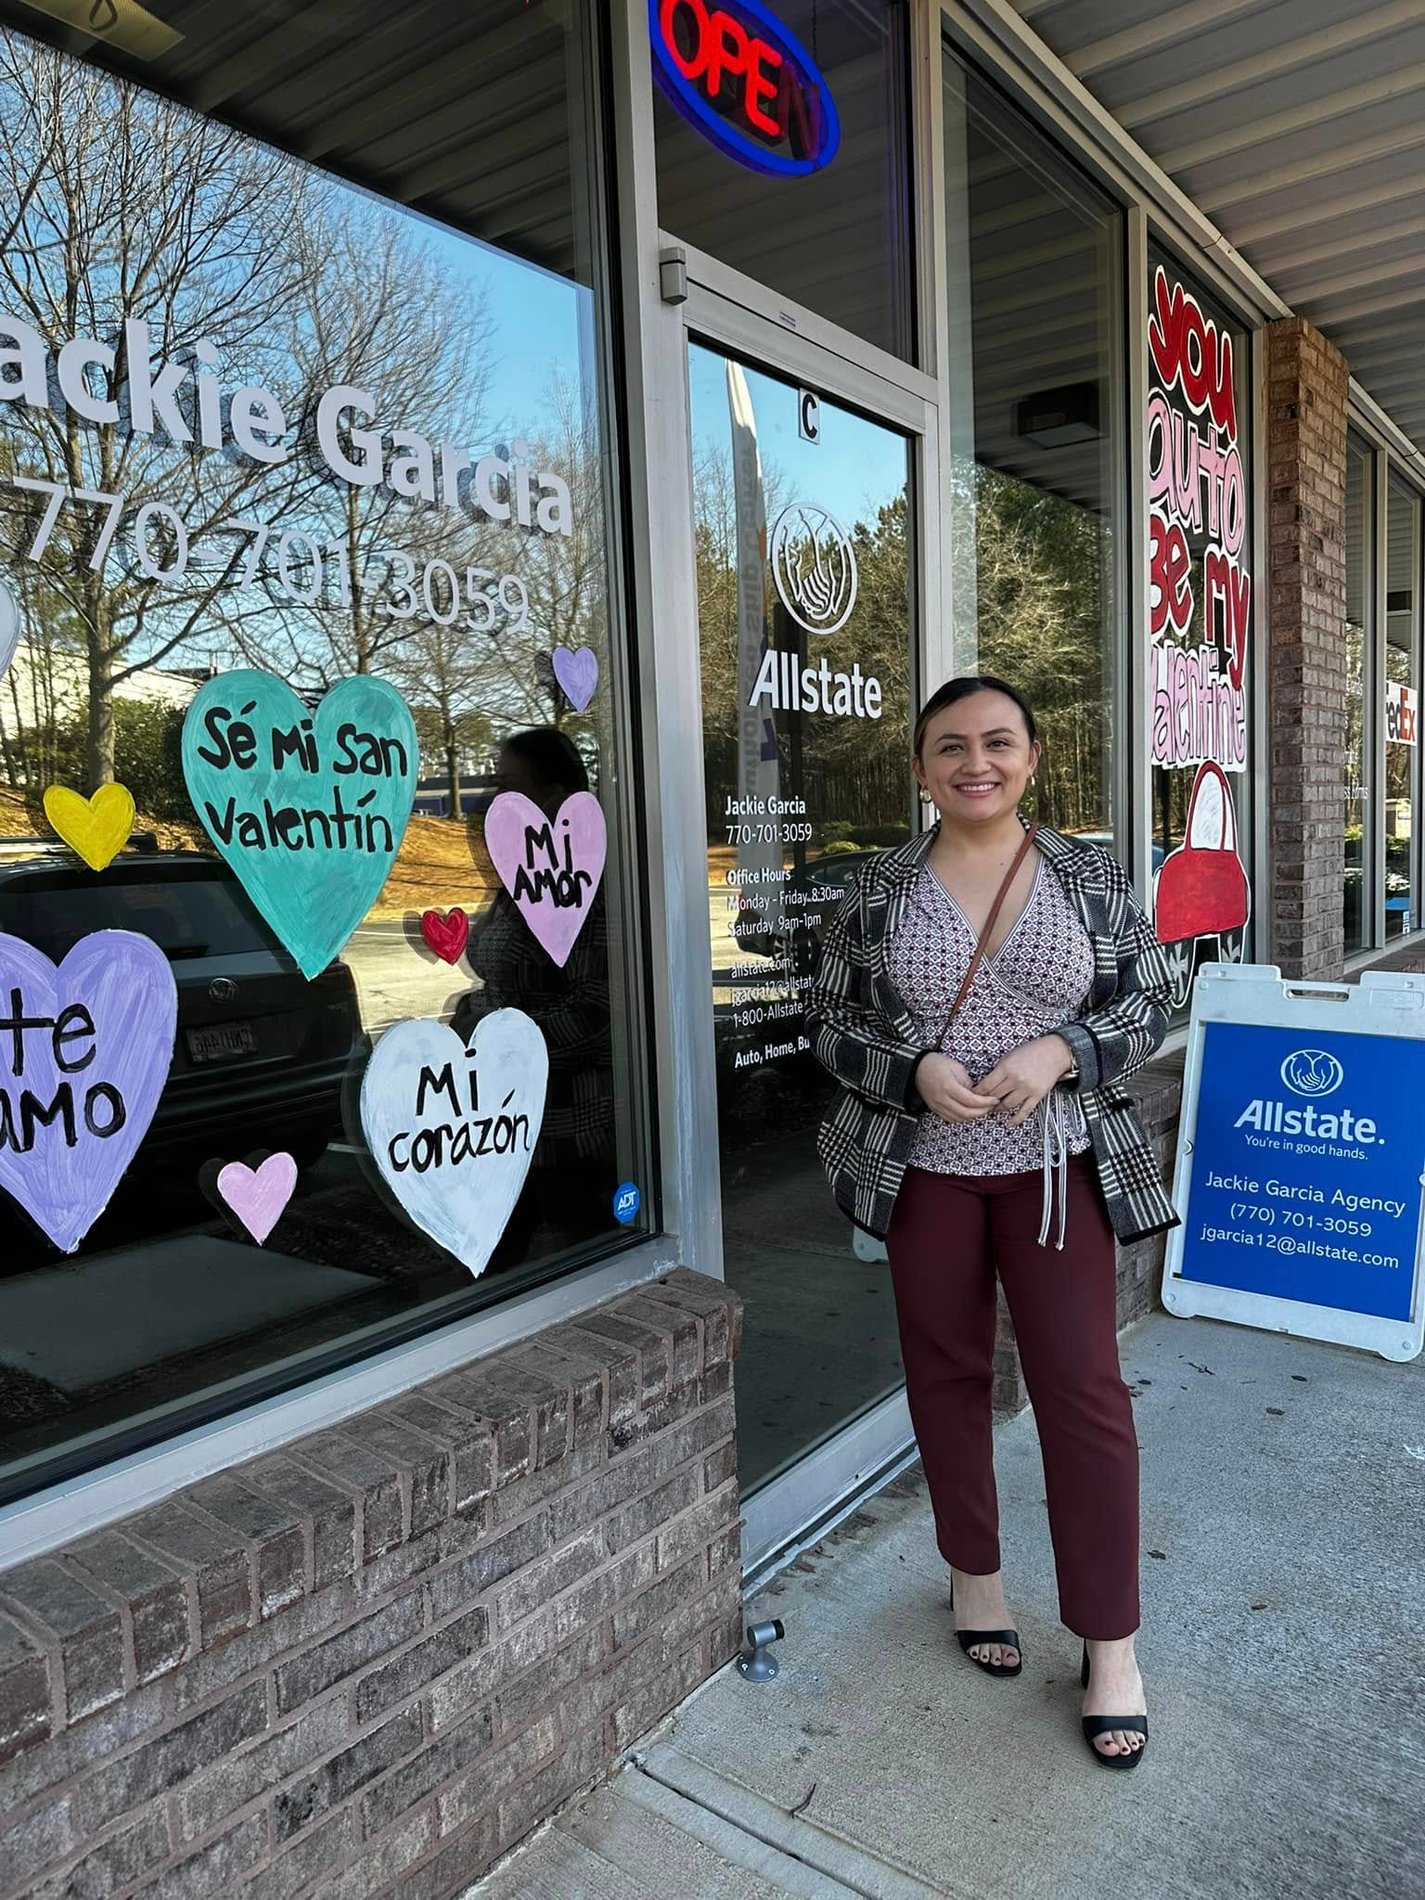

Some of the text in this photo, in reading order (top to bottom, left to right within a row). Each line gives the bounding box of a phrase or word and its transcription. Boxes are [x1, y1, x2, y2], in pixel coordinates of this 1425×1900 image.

[660, 0, 820, 162] OPEN
[802, 393, 818, 440] C
[317, 385, 573, 537] Garcia
[13, 475, 530, 636] 770-701-3059
[749, 649, 882, 719] Allstate
[197, 700, 258, 770] Sé
[1385, 682, 1416, 742] edEx
[203, 785, 394, 853] Valentín
[725, 795, 806, 816] Jackie Garcia
[525, 818, 573, 874] Mi
[725, 823, 813, 845] 770-701-3059
[727, 867, 792, 886] Office Hours
[727, 893, 770, 912] Monday
[811, 886, 845, 903] 8:30am
[728, 912, 822, 937] Saturday 9am-1pm
[731, 958, 791, 979] allstate.com
[732, 1000, 804, 1029] 1-800-Allstate
[734, 1051, 764, 1069] Auto,
[764, 1042, 797, 1061] Home,
[415, 1048, 479, 1117] Mi
[388, 1088, 530, 1174] corazón
[1245, 1134, 1369, 1161] You're in good hands.
[617, 1191, 637, 1211] ADT
[1205, 1171, 1407, 1219] Jackie Garcia Agency
[1230, 1202, 1373, 1238] (770) 701-3059
[1200, 1223, 1400, 1270] jgarcia12@allstate.com
